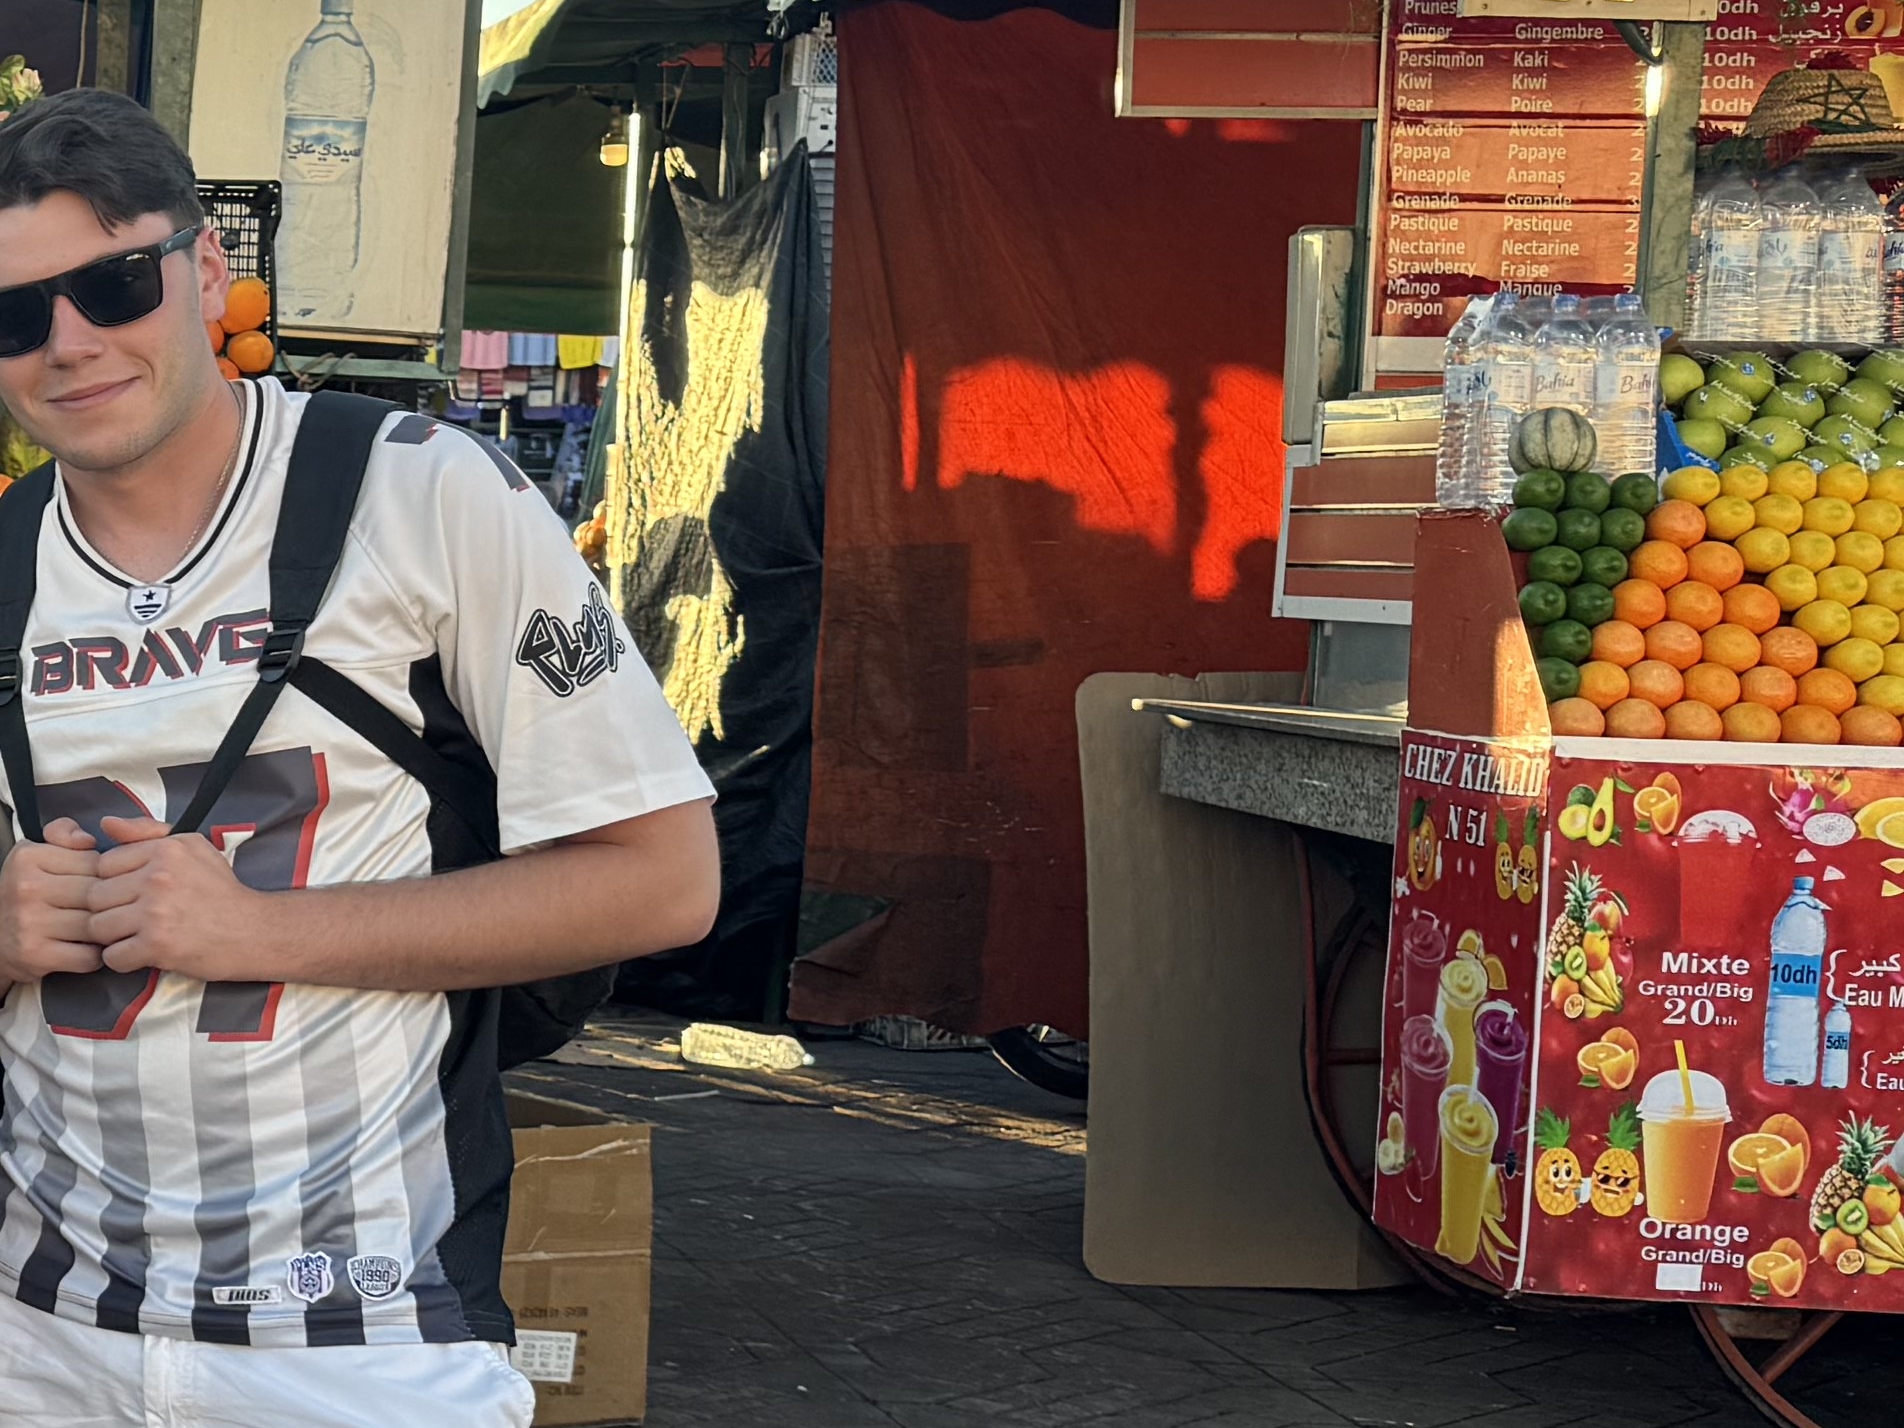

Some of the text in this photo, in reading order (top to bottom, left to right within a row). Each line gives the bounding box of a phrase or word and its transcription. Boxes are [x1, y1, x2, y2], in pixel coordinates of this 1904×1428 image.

[1718, 0, 1759, 14] 0dh
[1402, 23, 1757, 42] Ginger Gingembre 10dh
[1399, 51, 1755, 67] Persimmon Kaki 10dh
[1398, 73, 1754, 90] Kiwi Kiwi 10dh
[1397, 96, 1753, 113] Pear Poire 10dh
[1395, 121, 1564, 137] Avocado Avocat
[286, 138, 361, 162] سيدي علي
[1393, 144, 1566, 162] Papaya Papaye
[1393, 167, 1565, 184] Pineapple Ananas
[1392, 192, 1571, 209] Grenade Grenade
[1390, 215, 1572, 235] Pastique Pastique
[1389, 238, 1579, 256] Nectarine Nectarine
[1388, 258, 1549, 277] Strawberry Fraise
[1387, 281, 1563, 297] Mango Mangue
[1385, 299, 1443, 318] Dragon
[1536, 373, 1575, 392] Bahia
[1404, 743, 1545, 797] CHEZ KHALID
[1445, 804, 1487, 847] N 51
[1661, 951, 1750, 975] Mixte
[1849, 953, 1901, 978] كبير
[1771, 963, 1818, 985] 10dh
[1638, 980, 1754, 1002] Grand/Big
[1844, 984, 1882, 1007] Eau
[1826, 1034, 1848, 1051] 5dh
[1639, 1216, 1749, 1247] Orange
[1641, 1246, 1744, 1268] Grand/Big
